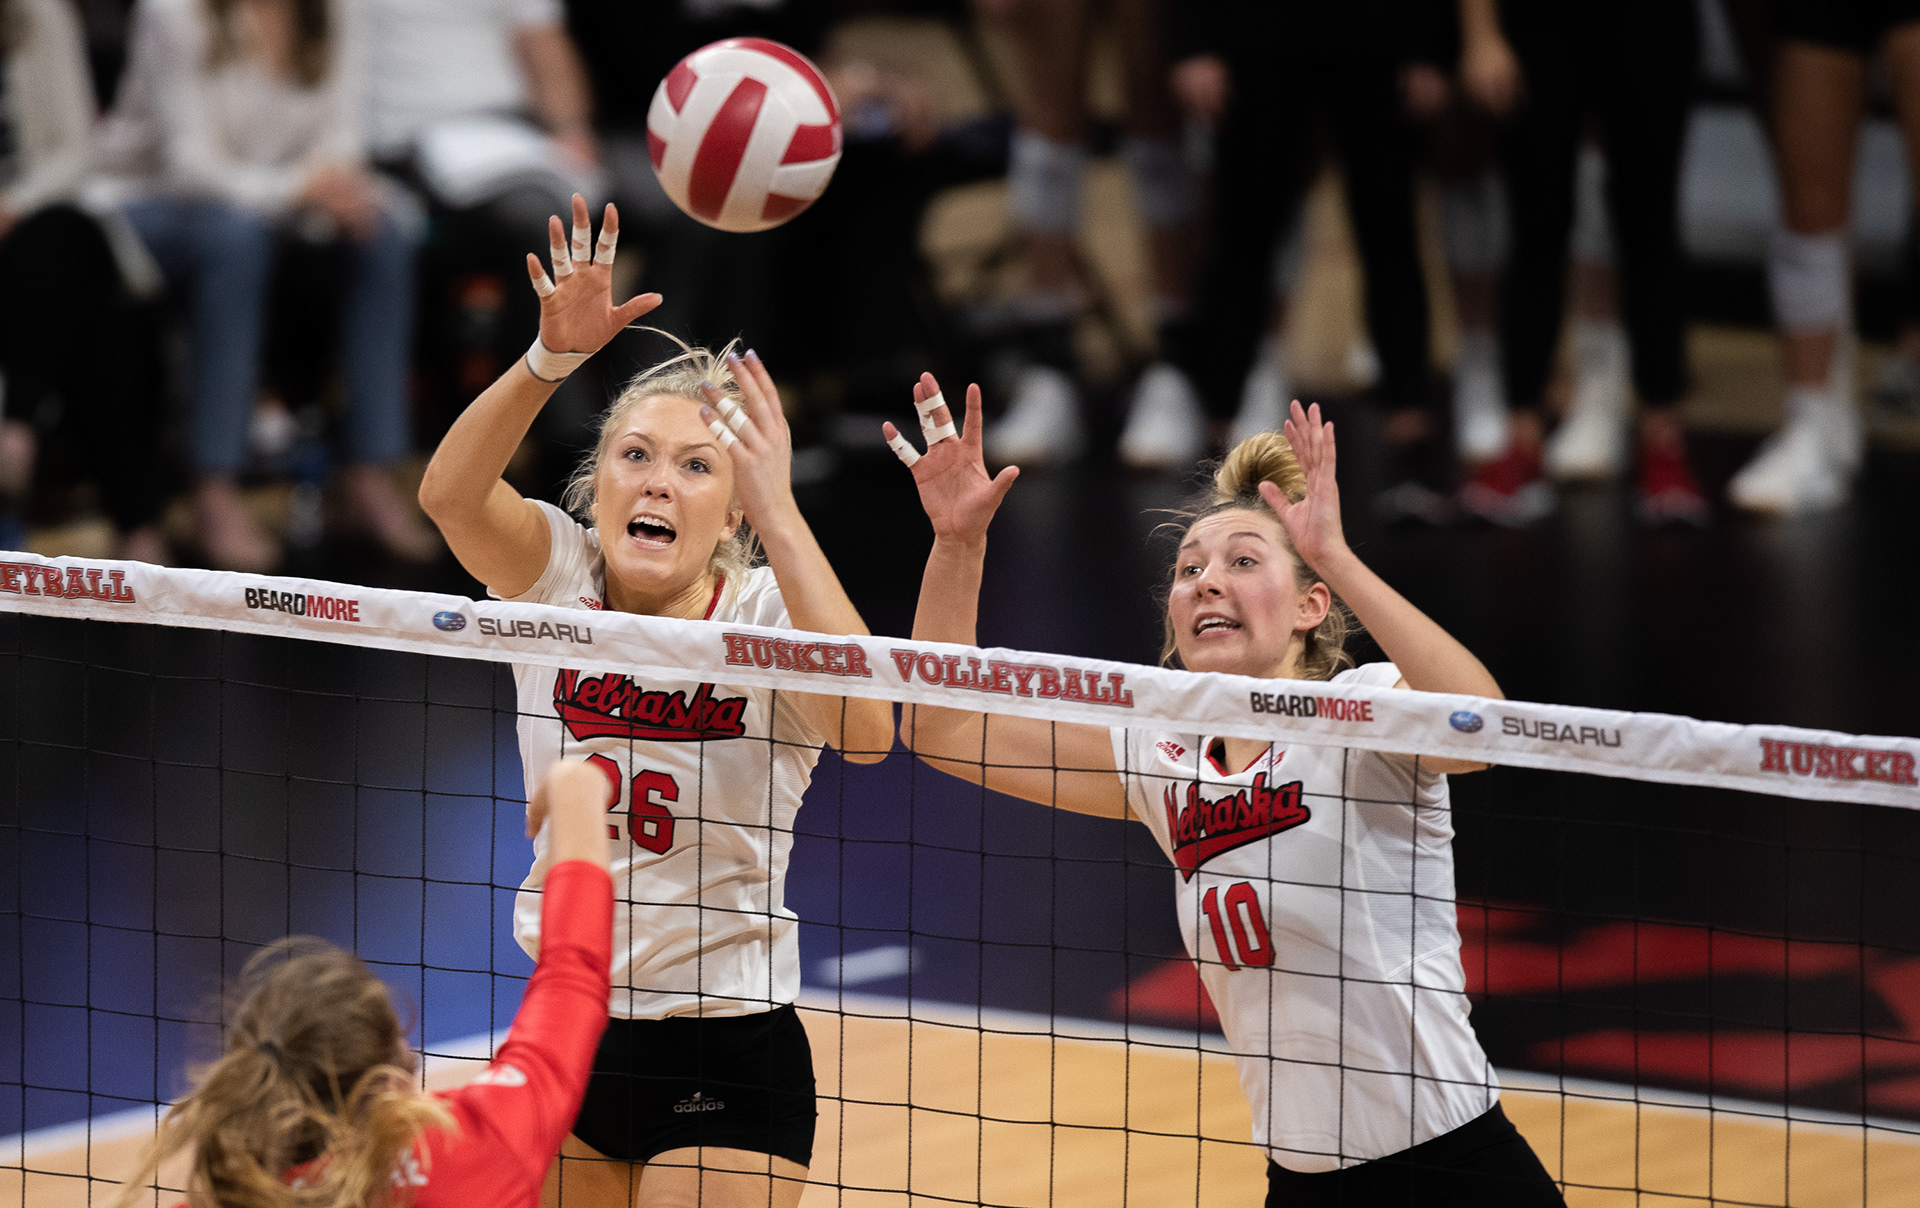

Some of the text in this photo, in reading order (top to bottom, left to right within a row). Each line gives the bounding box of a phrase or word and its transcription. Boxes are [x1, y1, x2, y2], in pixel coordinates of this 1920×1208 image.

[245, 588, 360, 622] BEARDMORE
[478, 617, 593, 645] SUBARU
[723, 633, 1134, 708] HUSKER VOLLEYBALL
[554, 668, 747, 738] Nebraska
[1250, 691, 1374, 722] BEARDMORE
[1501, 716, 1622, 748] SUBARU
[1760, 738, 1918, 786] HUSKER
[1164, 771, 1311, 858] Nebraska
[1202, 881, 1276, 971] 10
[673, 1100, 725, 1113] adidas
